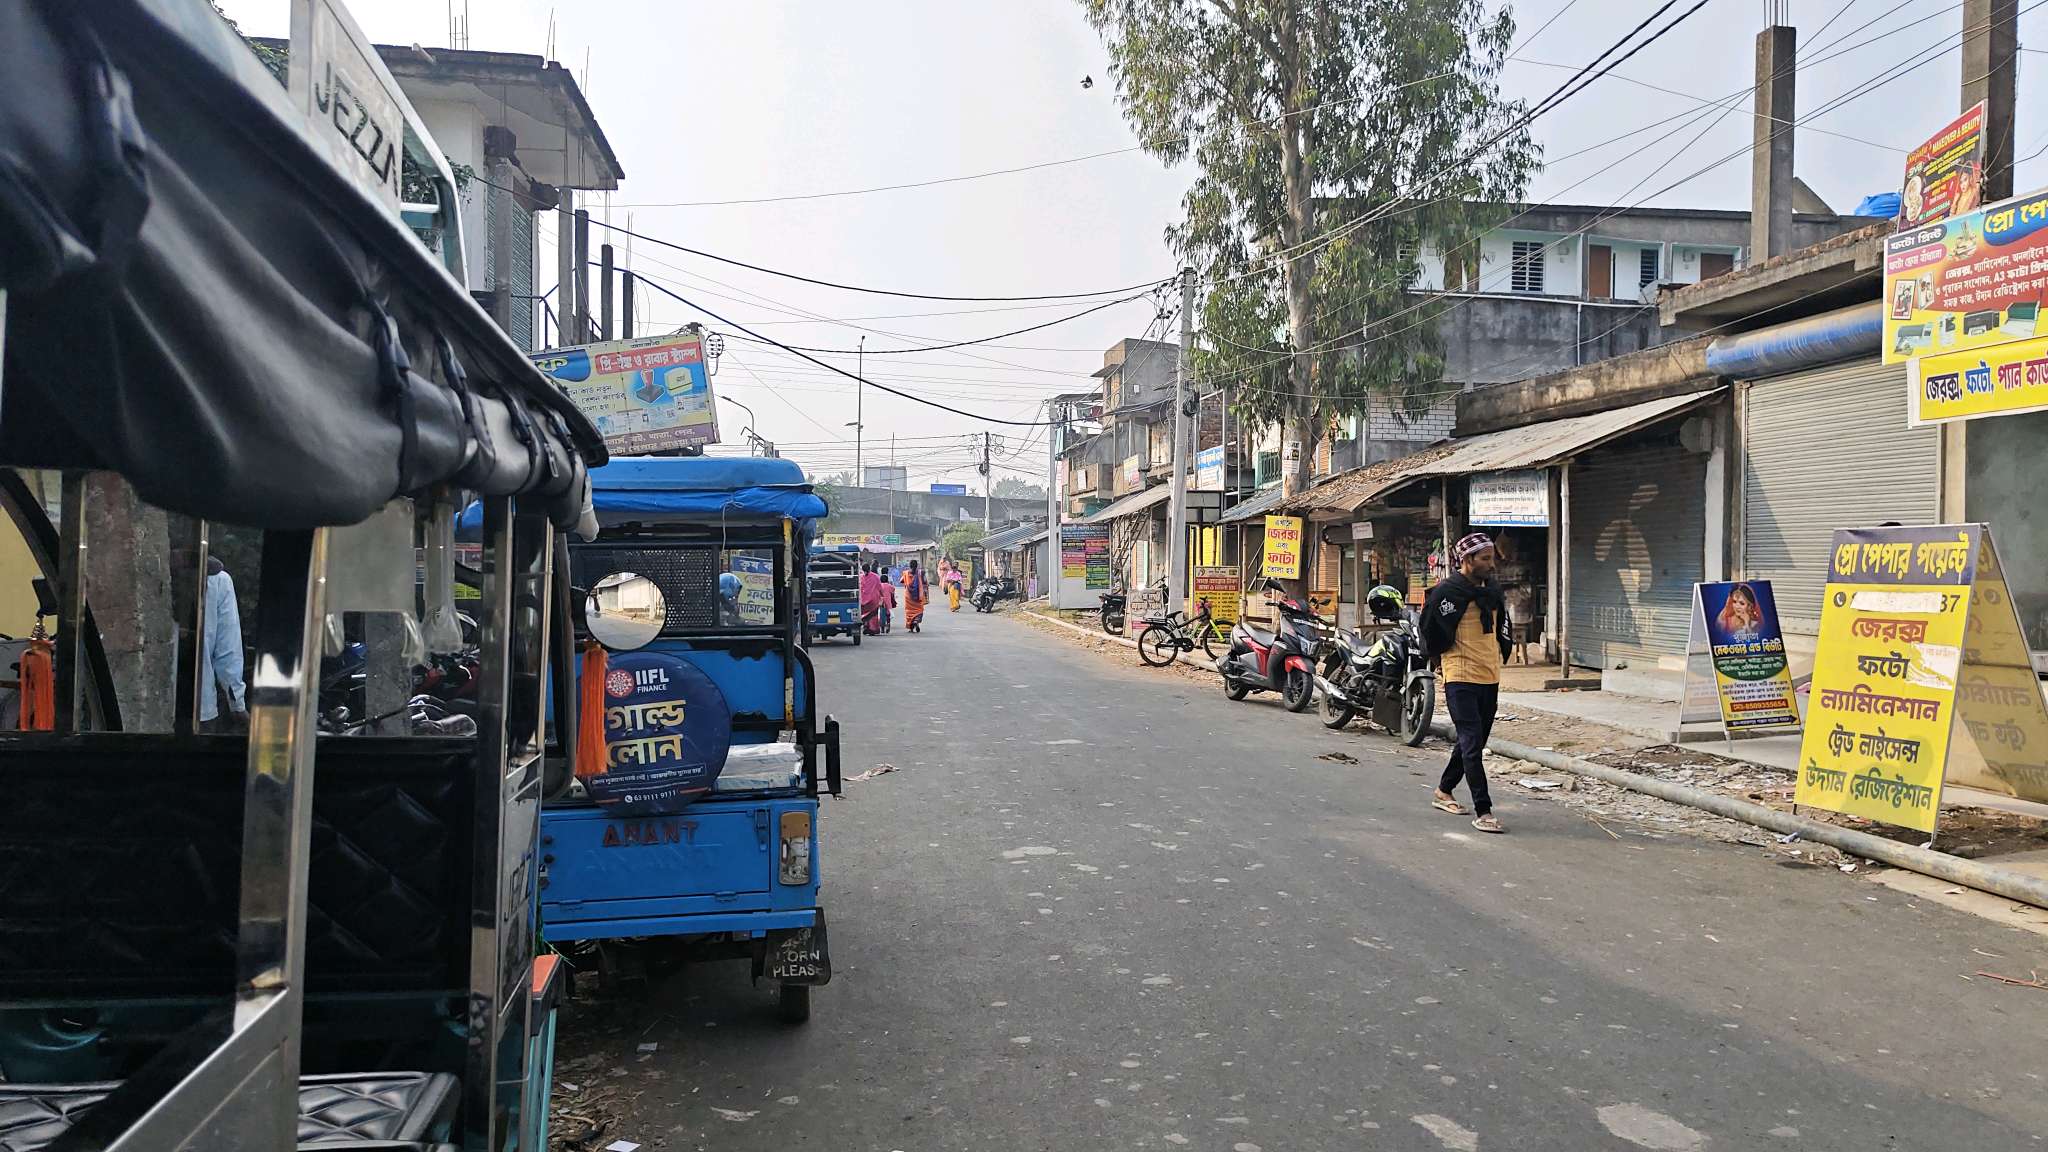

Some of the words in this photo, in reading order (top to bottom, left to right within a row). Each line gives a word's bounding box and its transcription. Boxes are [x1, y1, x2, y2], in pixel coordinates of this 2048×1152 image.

[315, 61, 398, 197] JEZZA
[1985, 207, 2015, 233] প্রো
[2020, 199, 2048, 224] পে
[1890, 237, 1915, 250] ফটো
[1994, 271, 2005, 282] A3
[1965, 360, 1994, 395] ফটো,
[1997, 362, 2022, 390] প্যান
[1834, 543, 1859, 576] প্রো
[1862, 542, 1913, 580] পেপার
[1916, 531, 1970, 580] পয়েন্ট
[1852, 617, 1929, 643] জেরক্স
[636, 668, 669, 686] IIFL
[1857, 651, 1910, 679] ফটো
[637, 684, 667, 694] FINANCE
[1821, 683, 1940, 721] ল্যামিনেশান
[606, 733, 683, 768] লোন
[1828, 723, 1856, 758] ট্রেড
[1860, 726, 1921, 764] লাইসেন্স
[604, 821, 699, 847] ANANT
